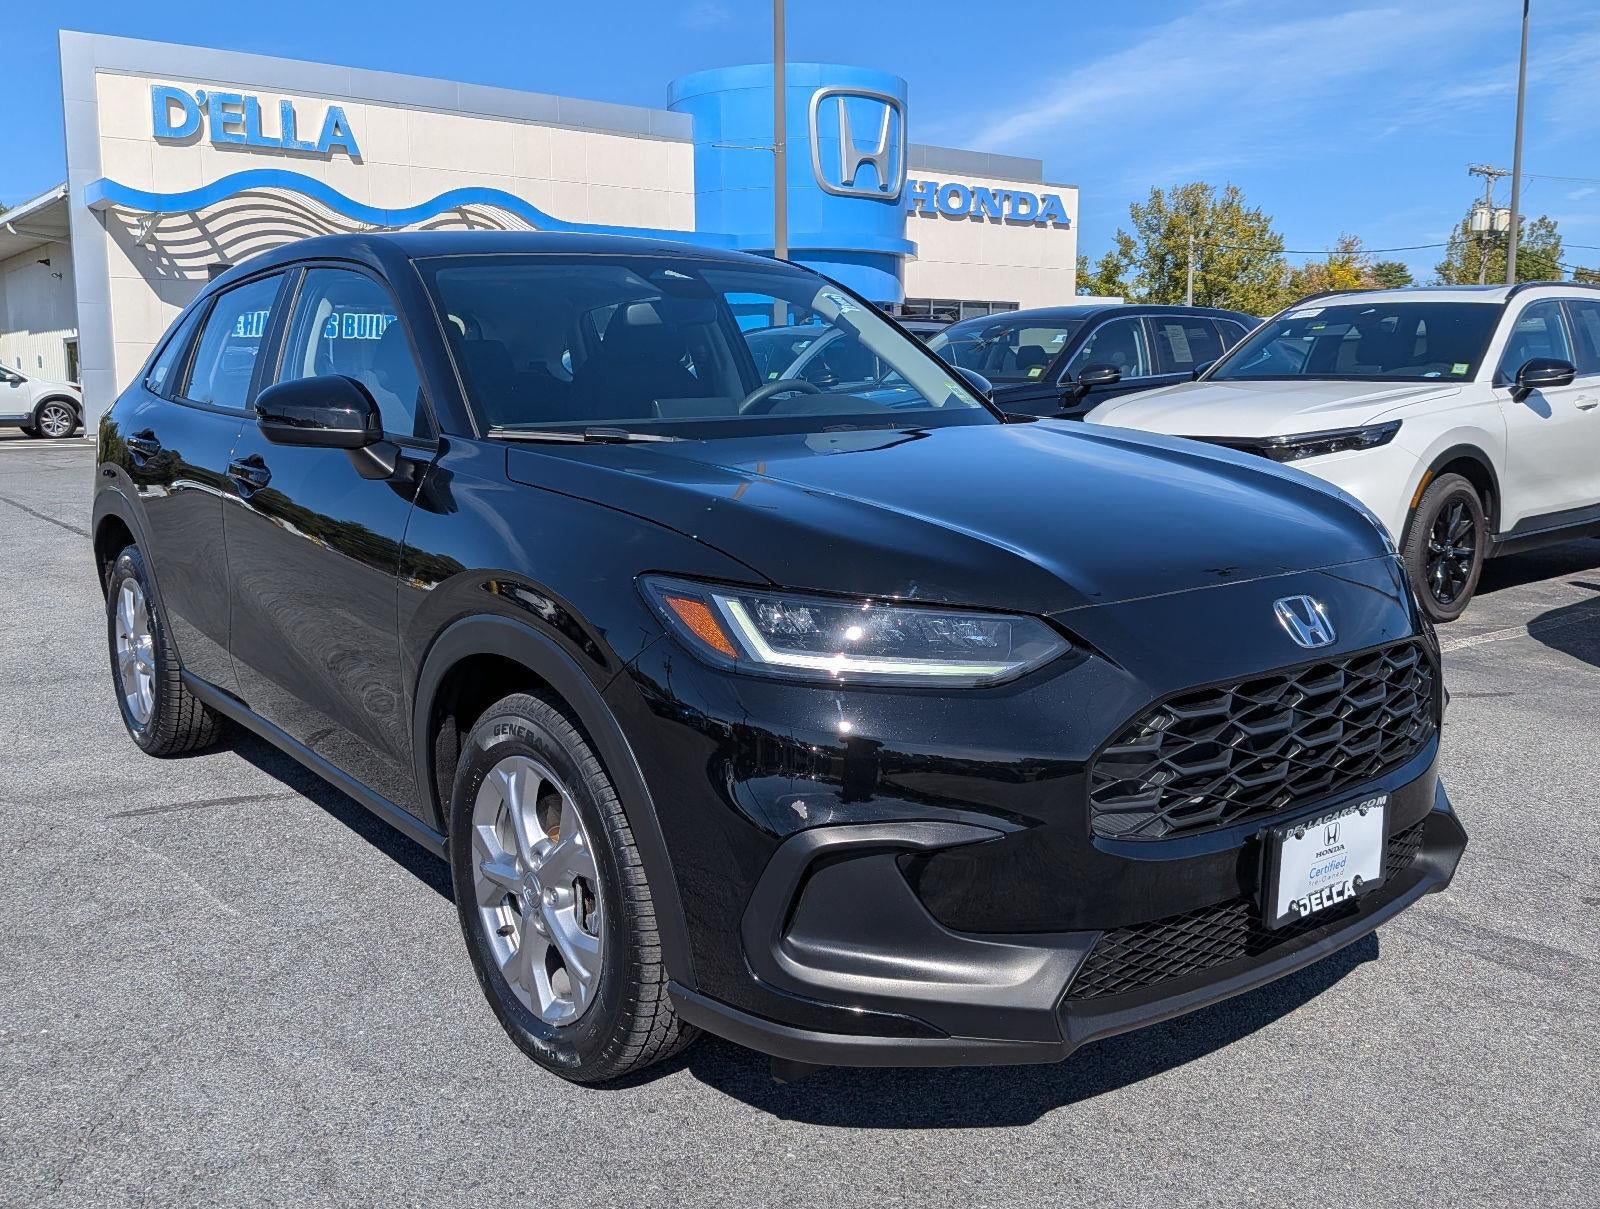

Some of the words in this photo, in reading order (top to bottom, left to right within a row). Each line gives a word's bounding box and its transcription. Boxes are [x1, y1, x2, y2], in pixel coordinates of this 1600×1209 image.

[151, 84, 362, 156] D'ELLA
[906, 179, 1072, 225] HONDA
[1309, 856, 1348, 879] Certified
[1315, 844, 1346, 858] HONDA
